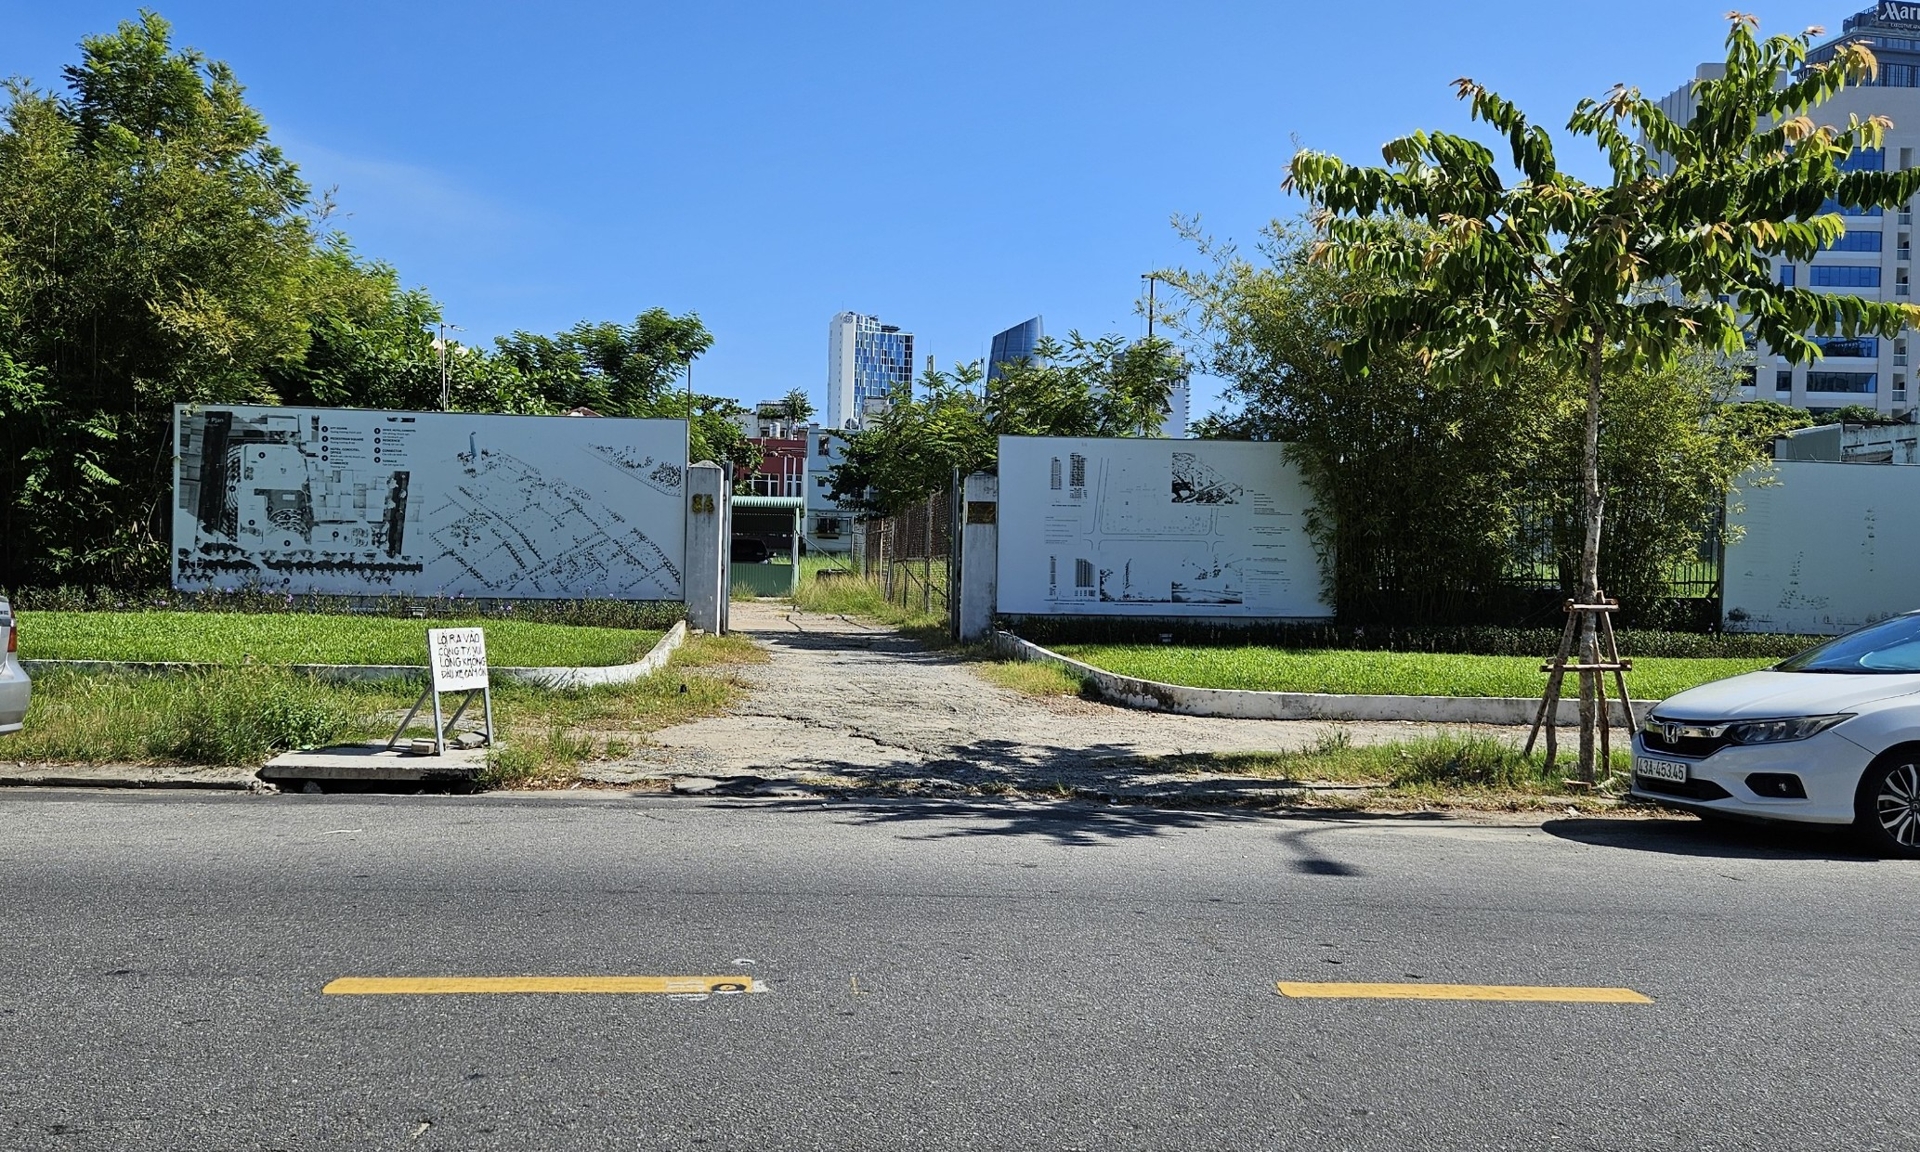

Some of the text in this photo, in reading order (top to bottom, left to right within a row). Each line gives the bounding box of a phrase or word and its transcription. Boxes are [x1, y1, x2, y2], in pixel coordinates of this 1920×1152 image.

[449, 633, 462, 644] RA
[463, 630, 480, 643] VÀO
[1638, 758, 1685, 781] 43A-453.45
